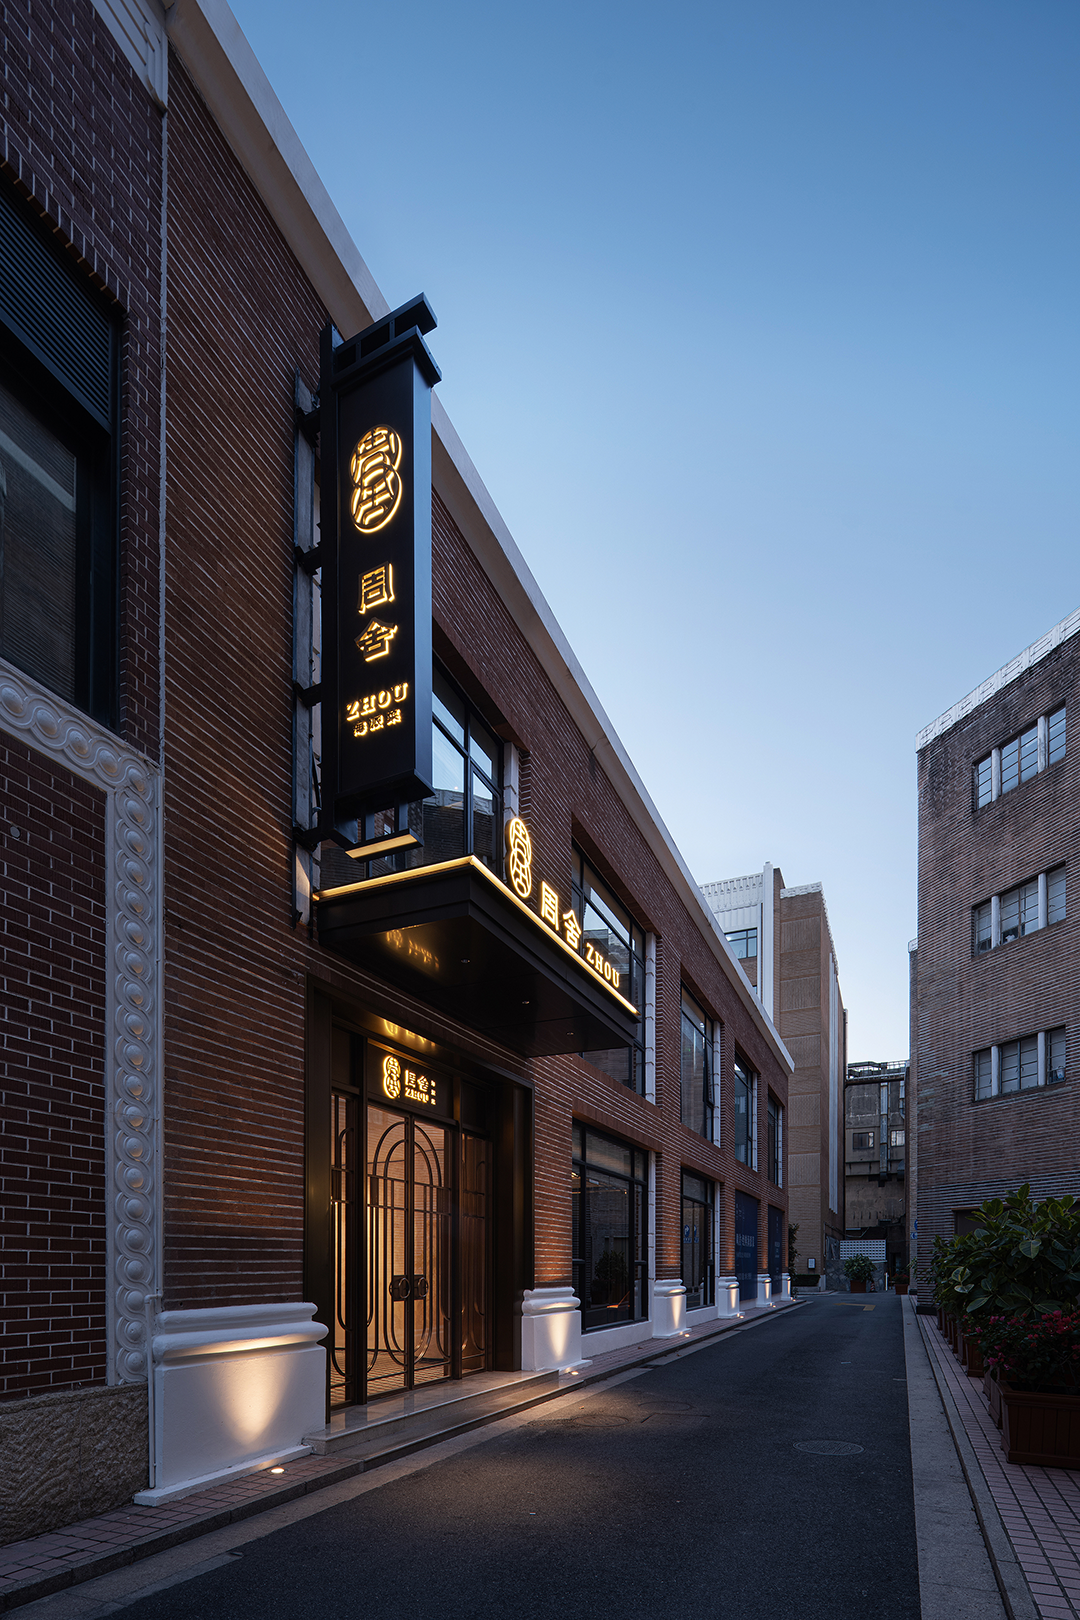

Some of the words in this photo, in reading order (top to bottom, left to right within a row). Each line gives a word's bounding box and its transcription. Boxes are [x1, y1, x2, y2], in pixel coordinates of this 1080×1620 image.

[354, 561, 398, 662] 周舍
[346, 682, 409, 721] ZHOU
[541, 880, 581, 949] 周舍
[585, 942, 620, 988] ZHOU
